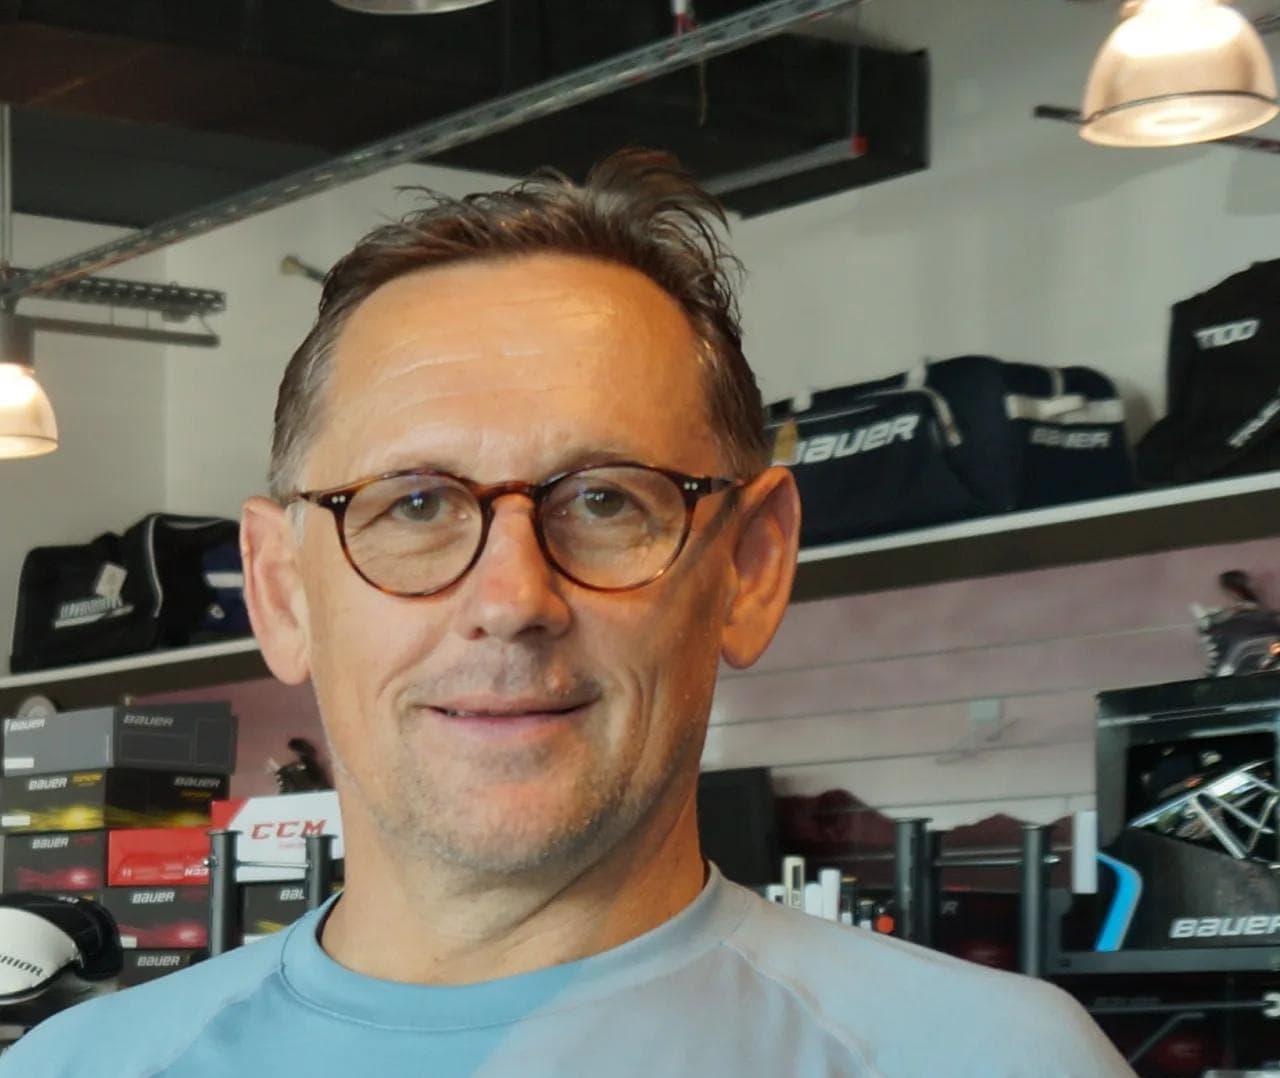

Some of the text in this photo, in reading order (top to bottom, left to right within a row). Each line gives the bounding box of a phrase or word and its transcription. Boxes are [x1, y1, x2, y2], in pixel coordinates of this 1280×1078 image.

[28, 777, 68, 792] BAUER
[250, 819, 327, 840] CCM
[31, 837, 69, 849] BAUER
[131, 891, 175, 904] BAUER
[137, 955, 181, 967] BAUER
